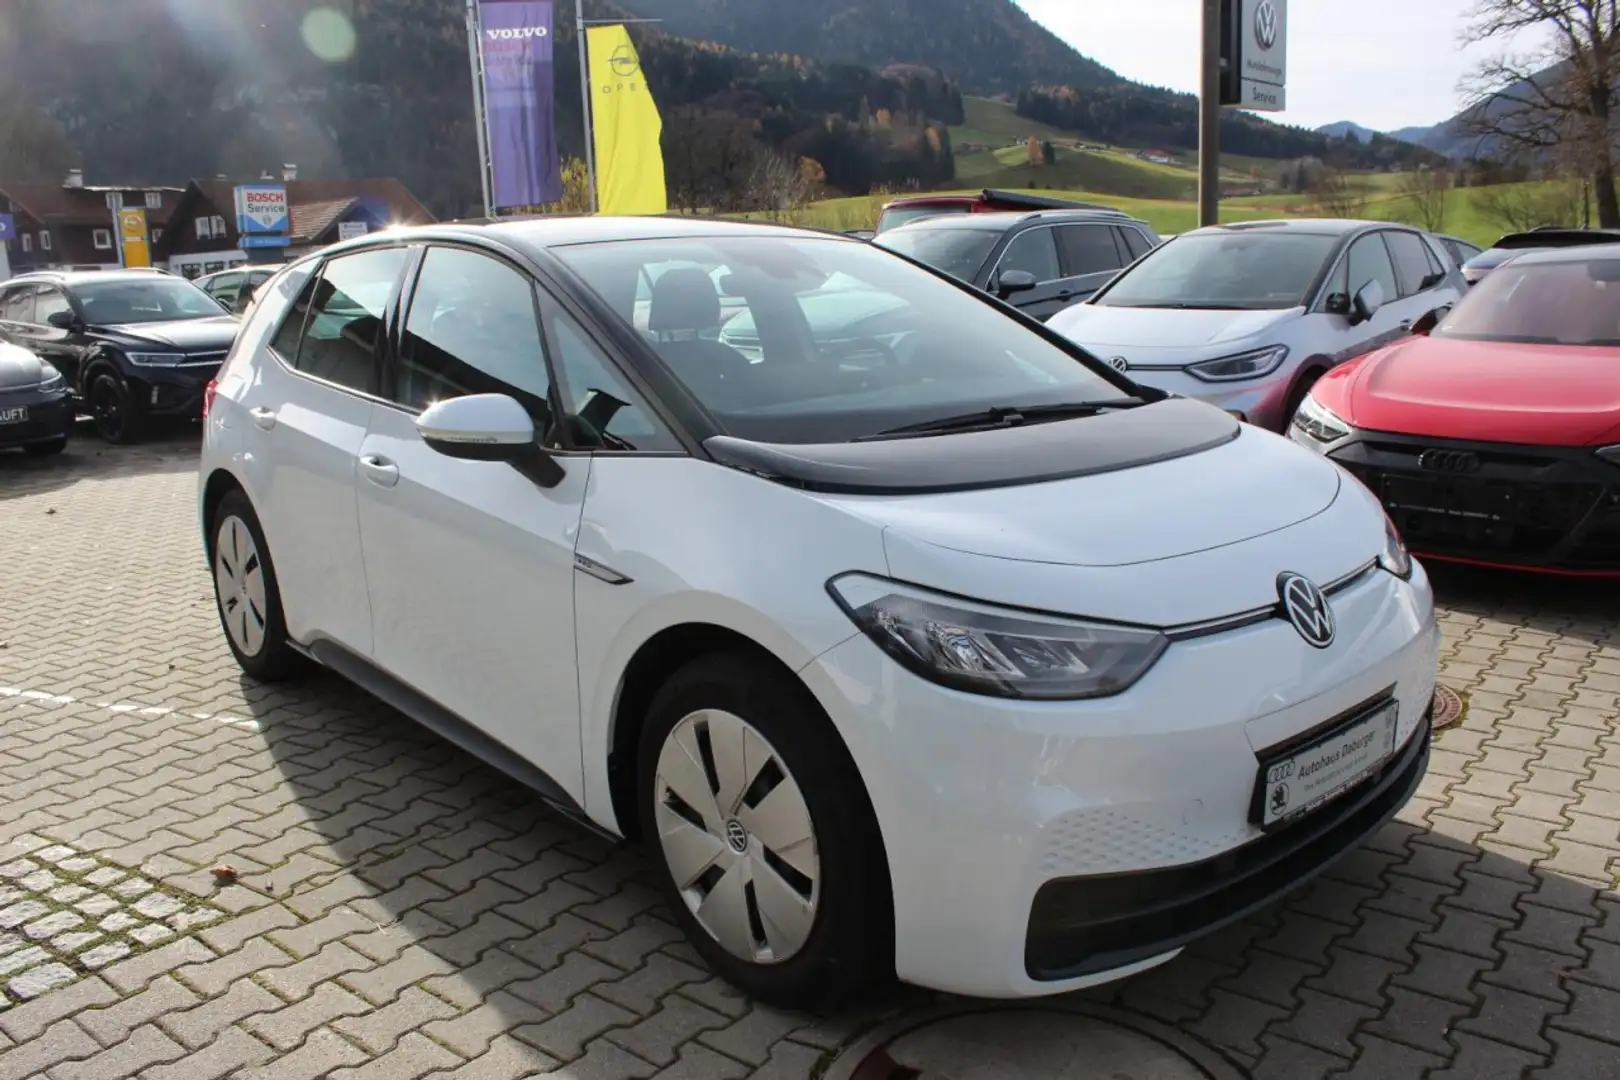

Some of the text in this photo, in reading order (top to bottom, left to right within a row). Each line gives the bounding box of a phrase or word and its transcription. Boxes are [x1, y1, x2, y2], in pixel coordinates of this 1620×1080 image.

[486, 26, 547, 40] VOLVO
[602, 82, 649, 94] OPE
[1252, 86, 1277, 105] Service
[246, 192, 284, 202] BOSCH
[248, 203, 285, 213] Service
[1298, 750, 1340, 781] Autohaus
